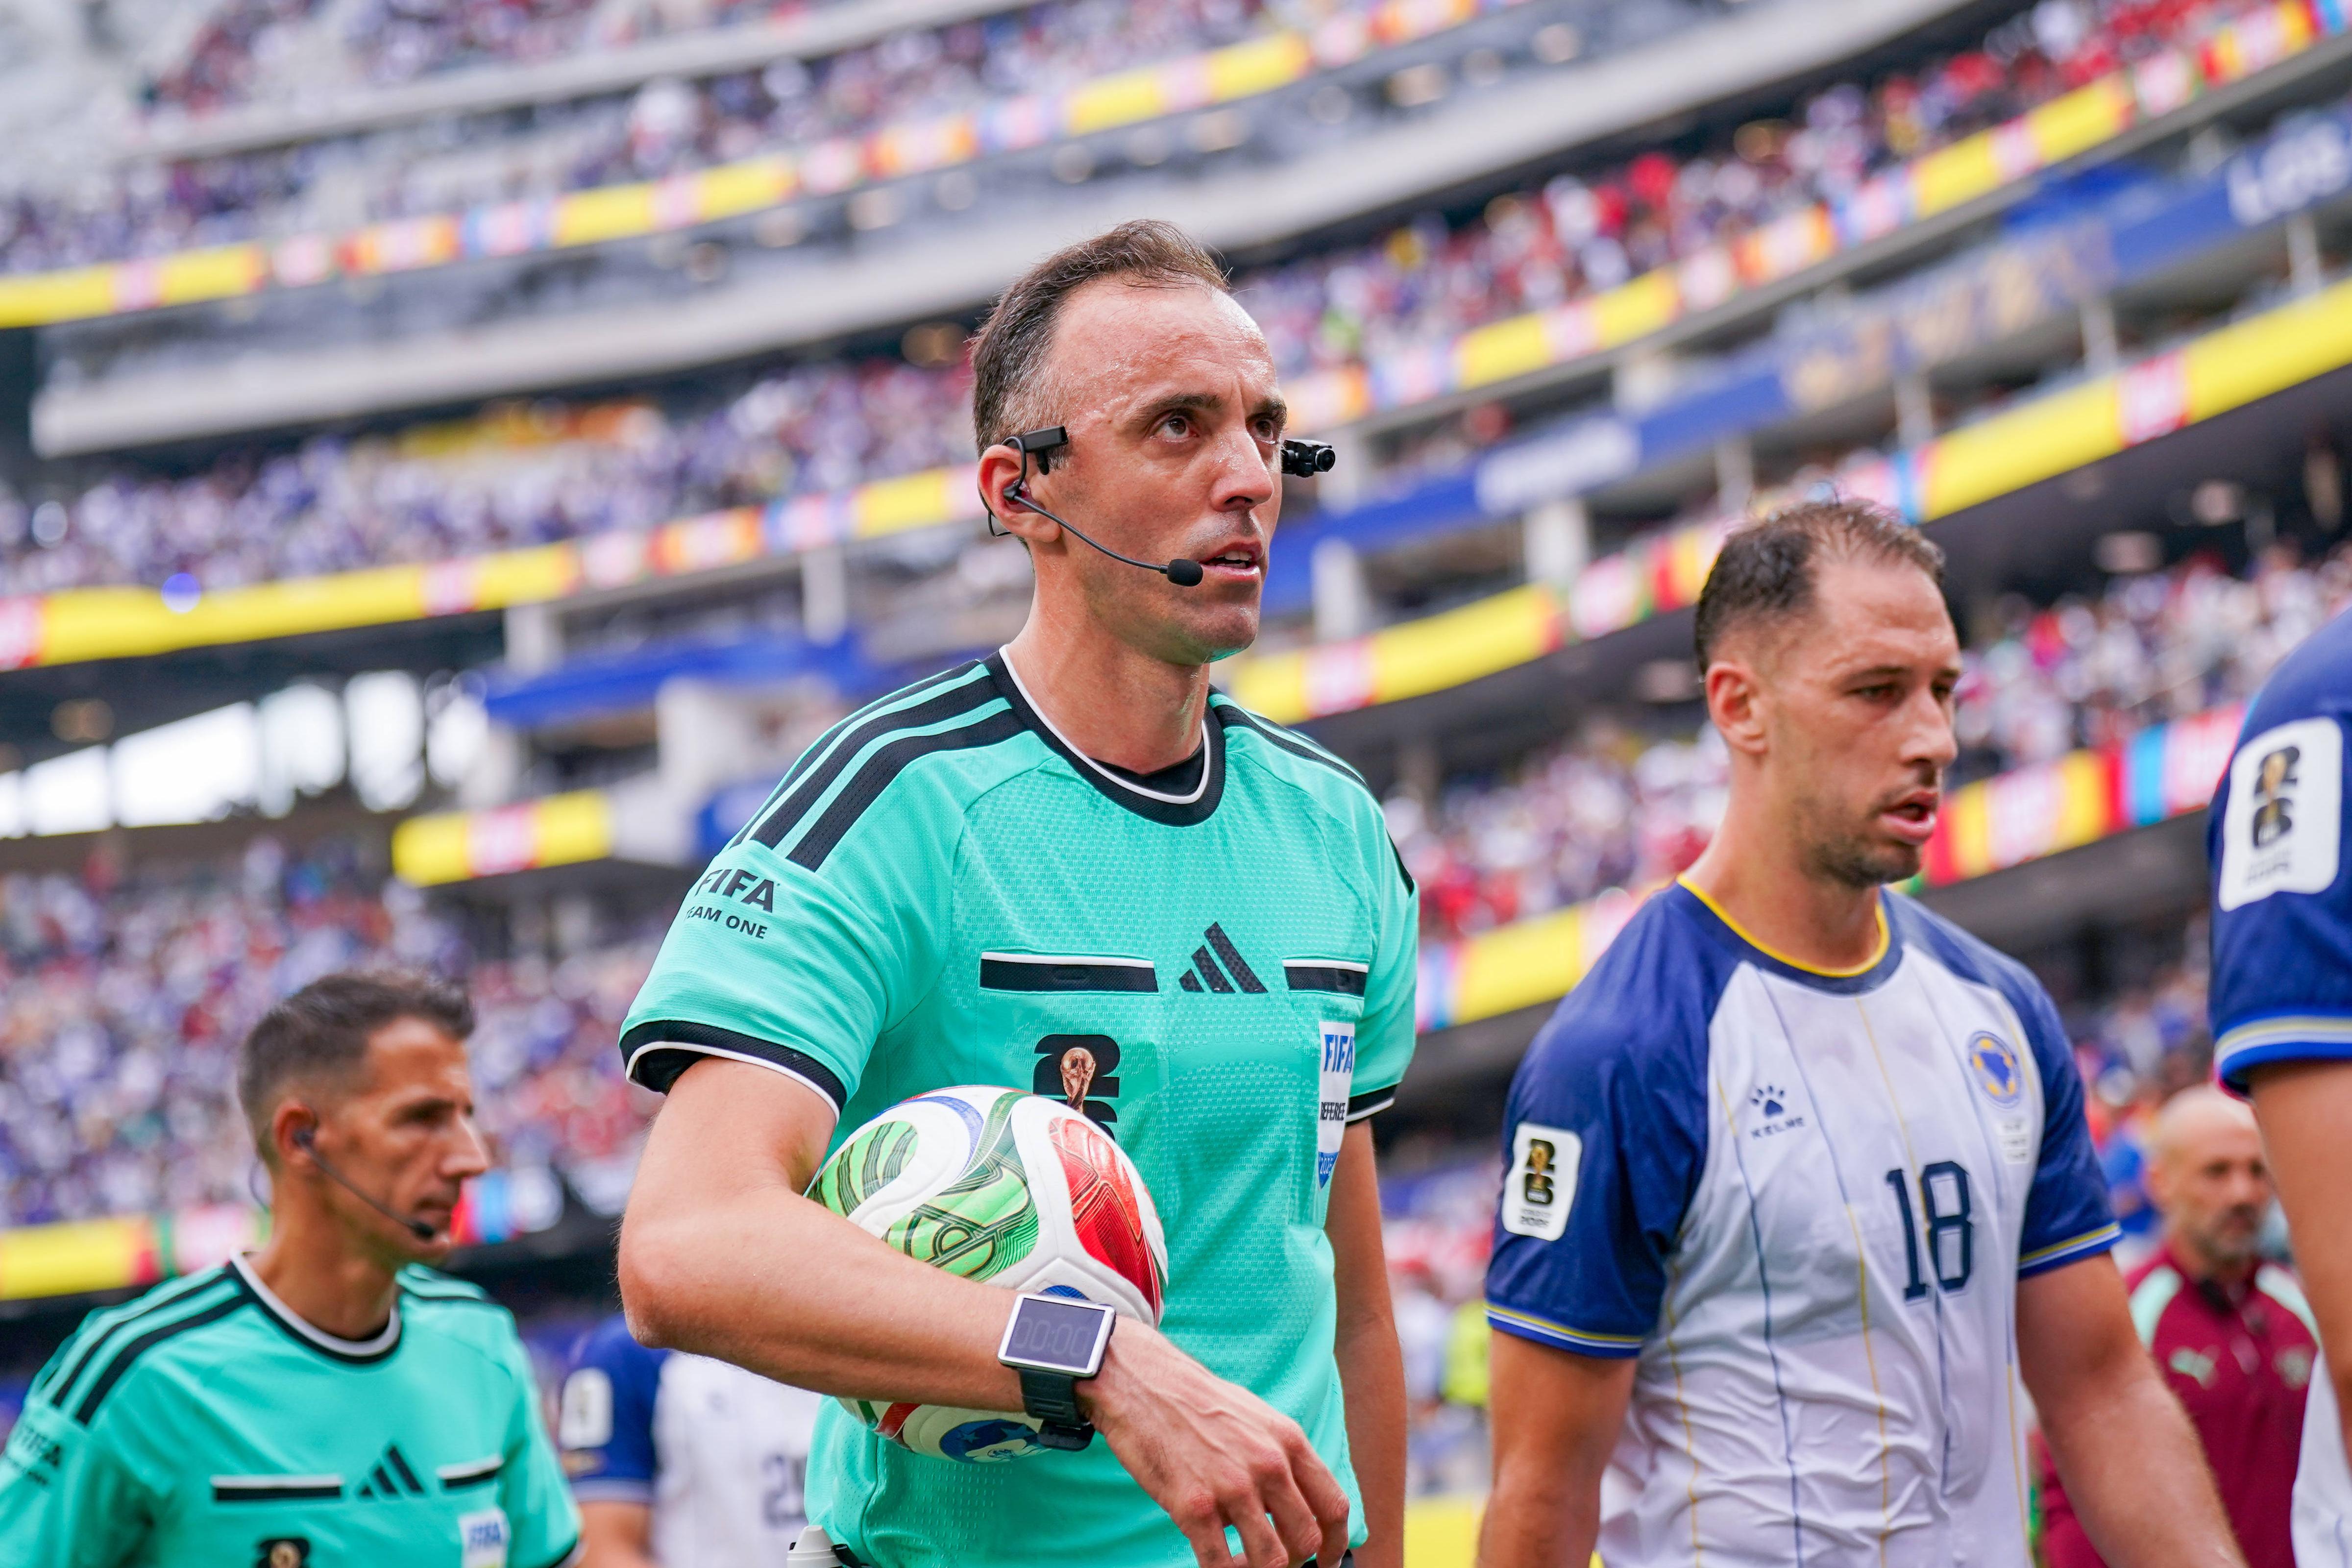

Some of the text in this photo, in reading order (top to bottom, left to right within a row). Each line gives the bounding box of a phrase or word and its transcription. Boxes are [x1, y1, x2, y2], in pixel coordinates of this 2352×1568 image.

[694, 869, 775, 913] FIFA
[726, 915, 768, 939] ONE
[1323, 1034, 1354, 1073] FIFA
[1320, 1102, 1346, 1121] REFEREE
[1886, 1160, 1973, 1302] 18
